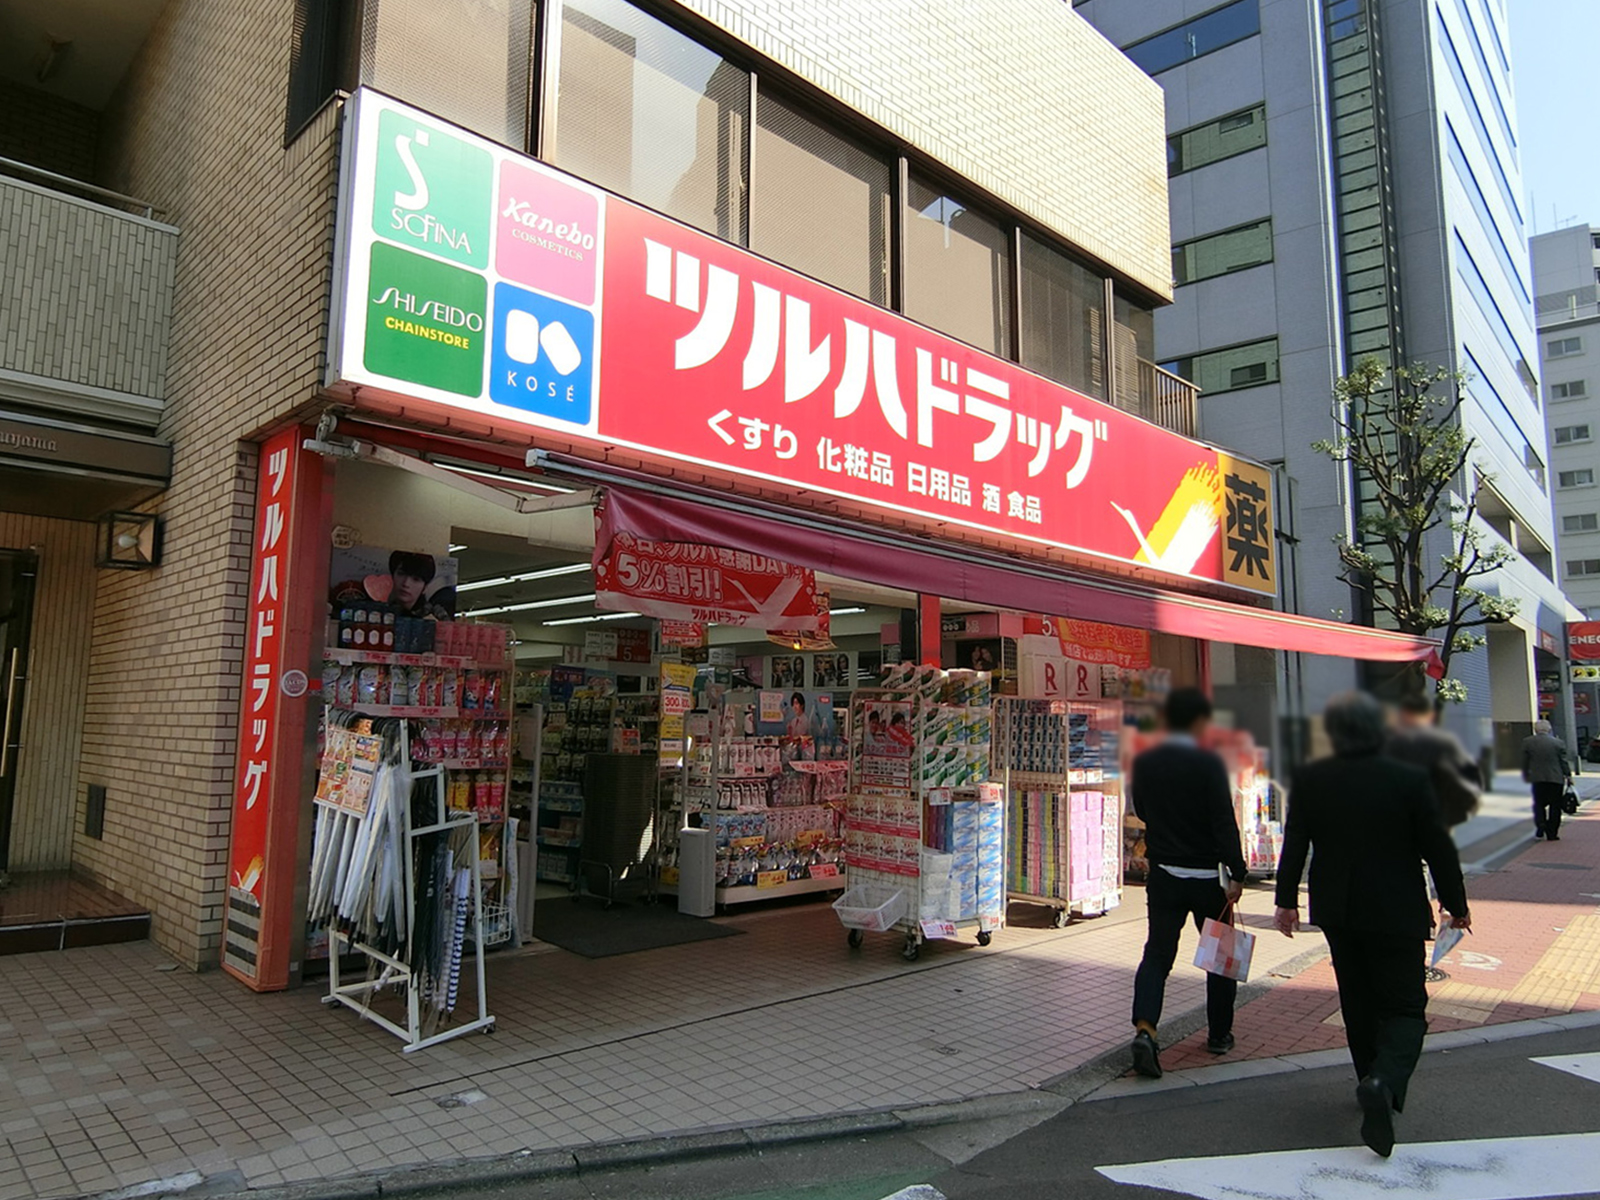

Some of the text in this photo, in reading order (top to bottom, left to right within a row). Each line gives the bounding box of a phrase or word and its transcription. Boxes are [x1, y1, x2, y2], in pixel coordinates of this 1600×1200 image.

[391, 208, 472, 255] SOFINA
[502, 197, 595, 250] Kanebo
[511, 228, 584, 262] COSMETICS
[372, 287, 484, 333] SHISEIDO
[385, 316, 470, 350] CHAINSTORE
[507, 370, 575, 403] KOSÉ
[643, 237, 1109, 490] ツルハドラッグ
[707, 408, 1043, 524] くすり 化粧品 日用品 酒 食品
[1224, 473, 1270, 581] 薬
[244, 448, 288, 811] ツルハドラッグ
